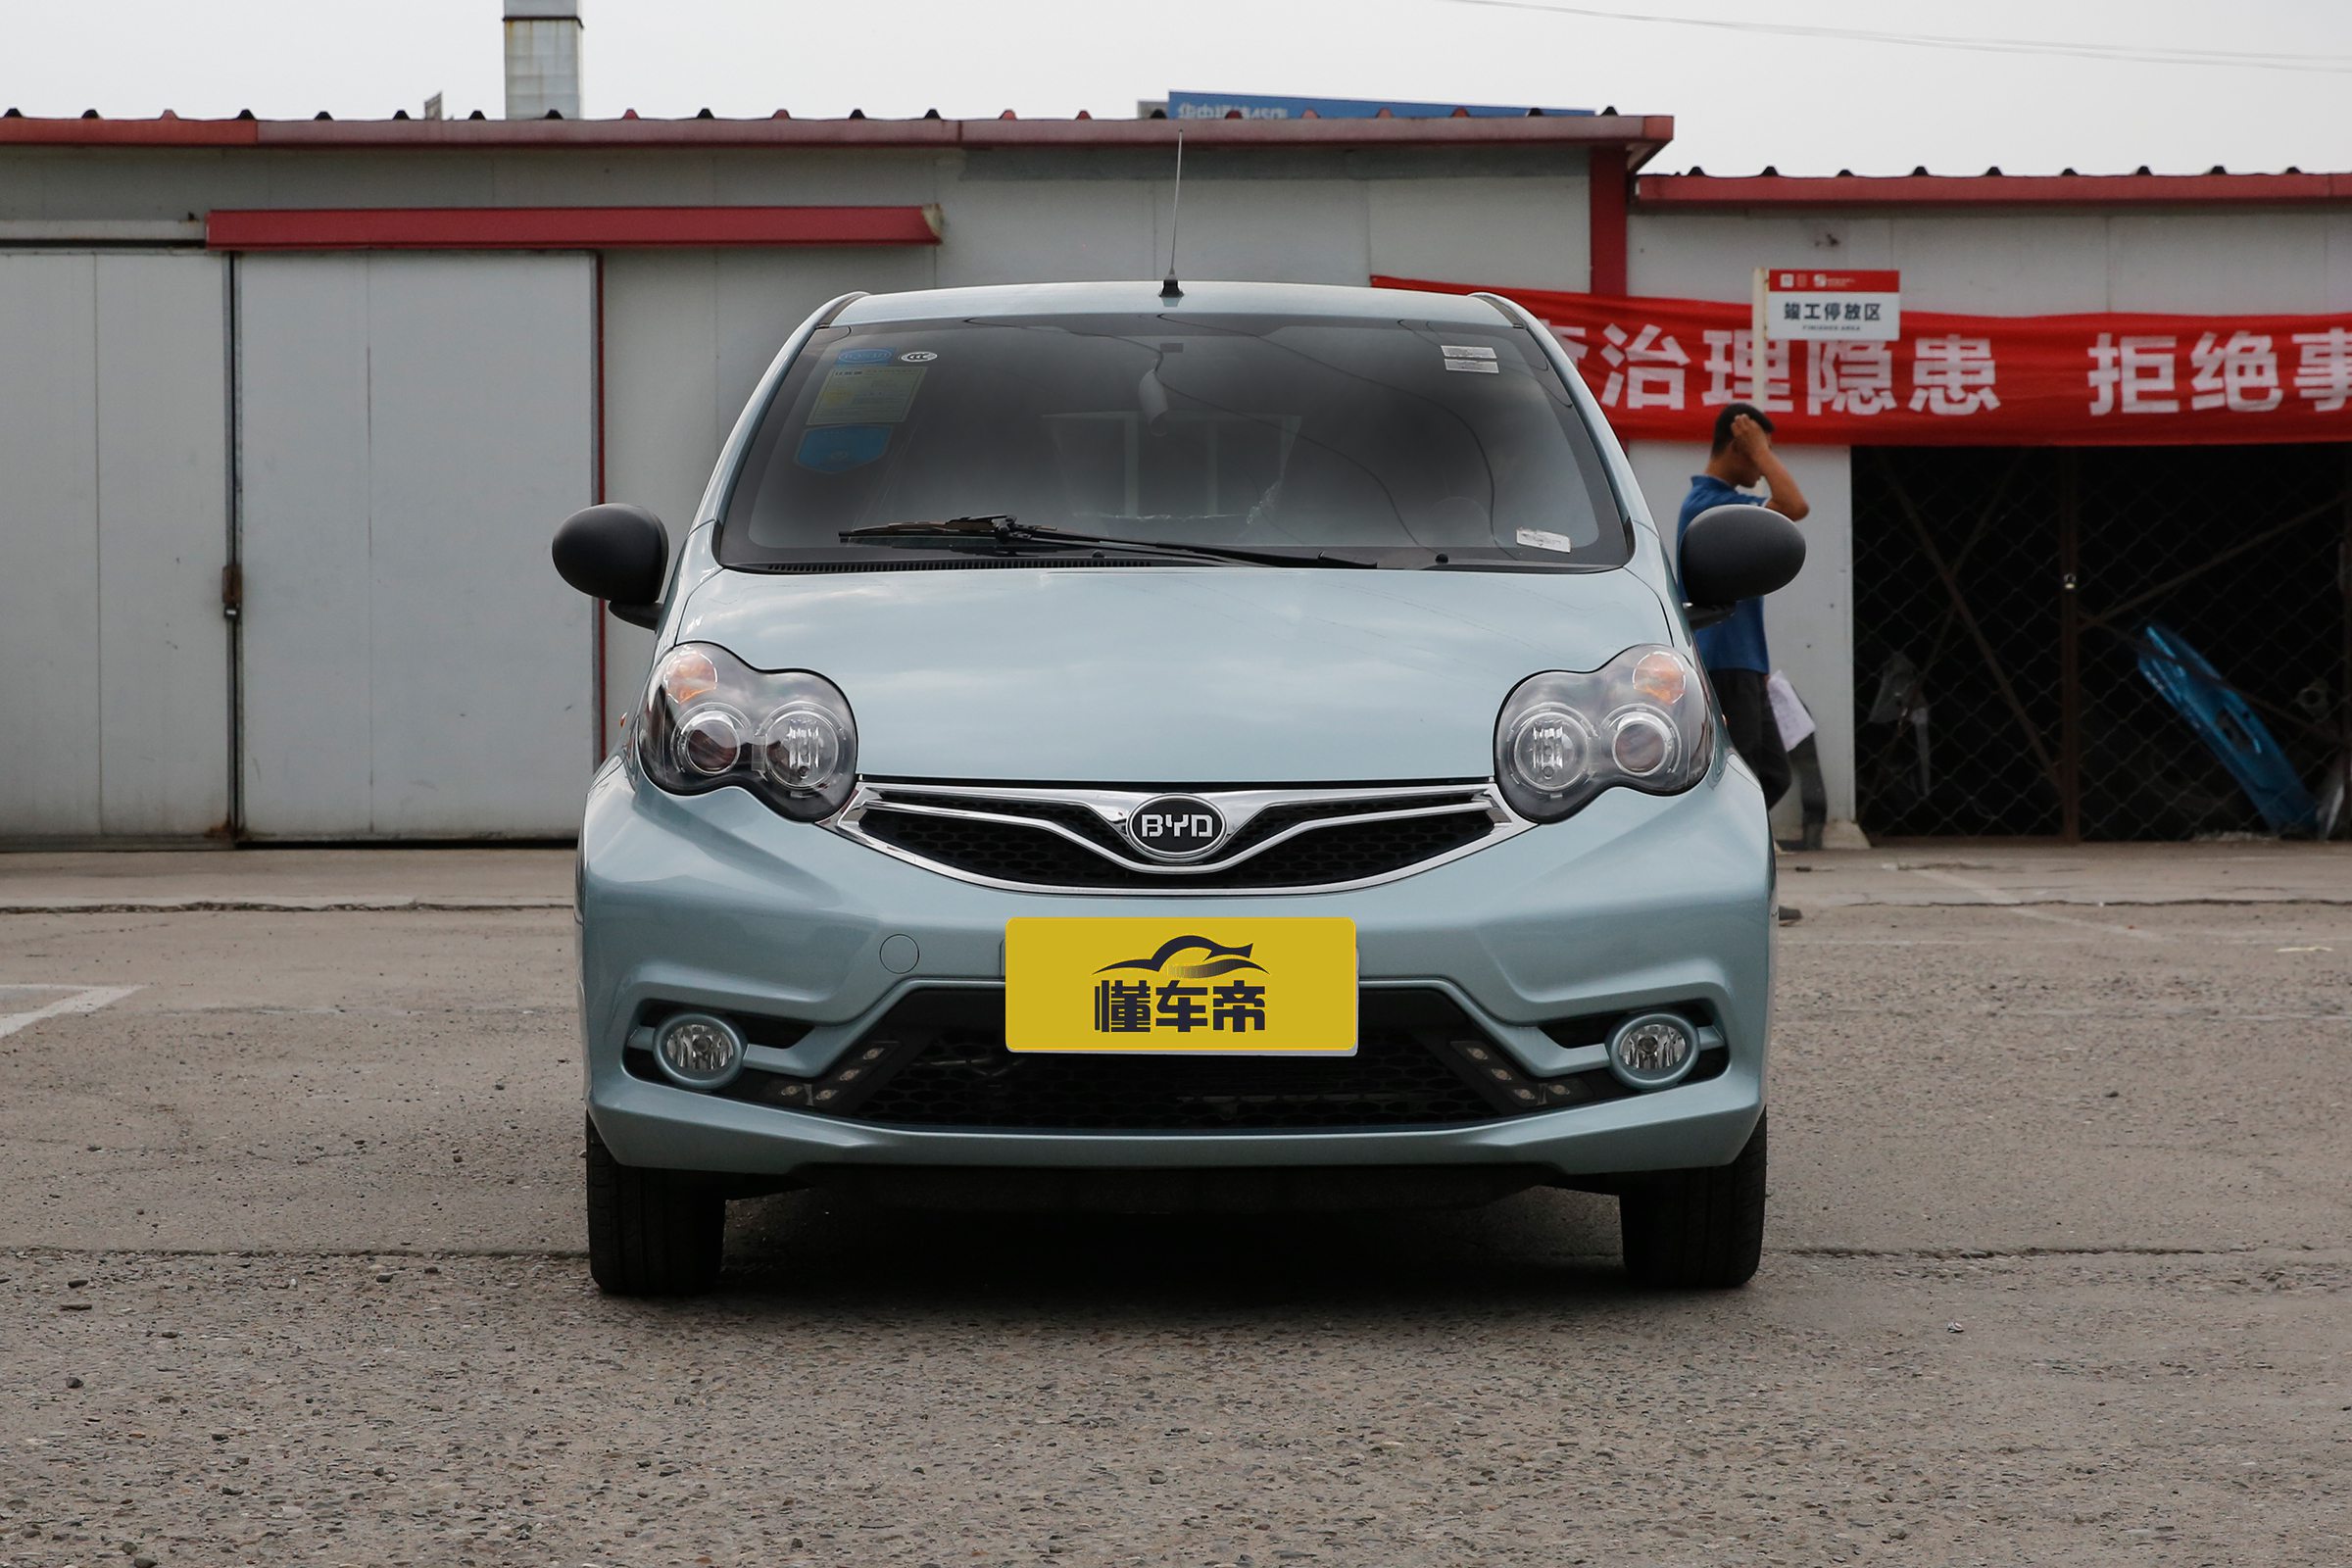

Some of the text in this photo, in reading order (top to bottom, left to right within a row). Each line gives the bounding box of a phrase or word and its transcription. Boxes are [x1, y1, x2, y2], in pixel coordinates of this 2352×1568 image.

[1784, 302, 1882, 321] 竣工停放区
[2087, 326, 2352, 416] 拒绝事
[1141, 813, 1214, 838] BYD
